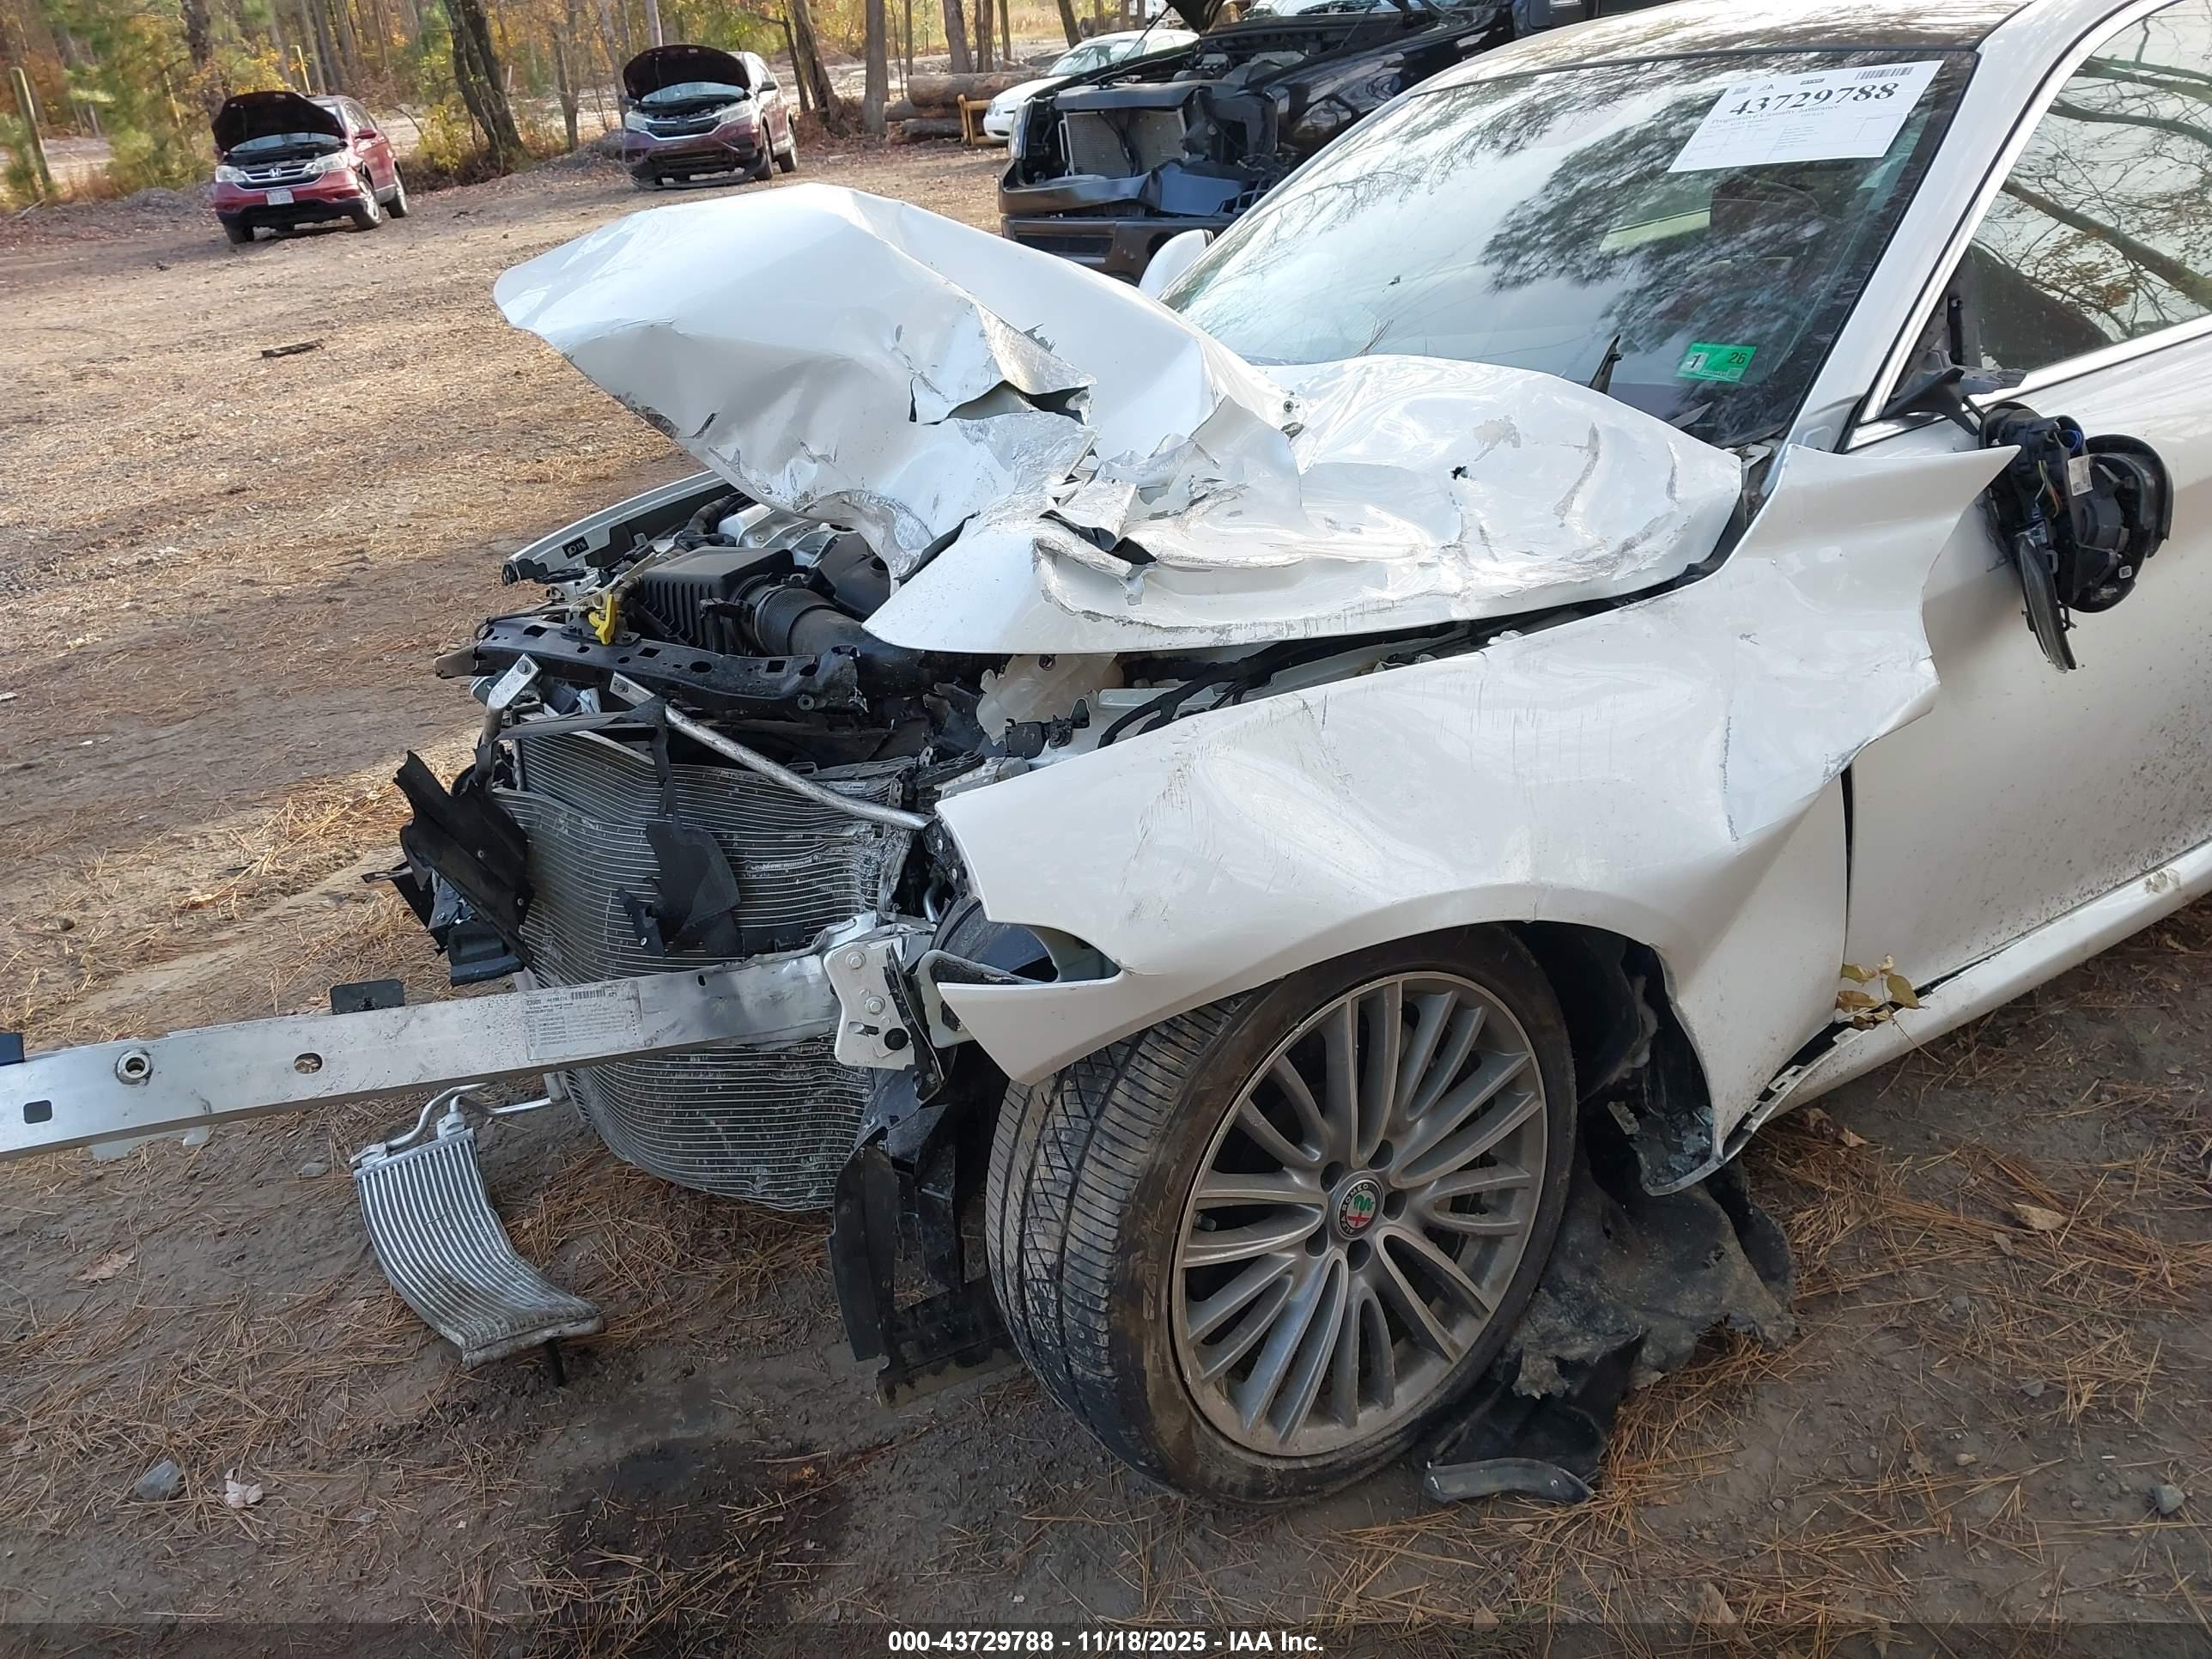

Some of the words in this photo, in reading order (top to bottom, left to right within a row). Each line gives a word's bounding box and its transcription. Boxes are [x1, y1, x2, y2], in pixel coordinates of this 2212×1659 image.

[1729, 82, 1899, 115] 43729788
[1692, 354, 1701, 368] 1
[1728, 352, 1747, 365] 26
[1341, 1184, 1368, 1211] ROMEO
